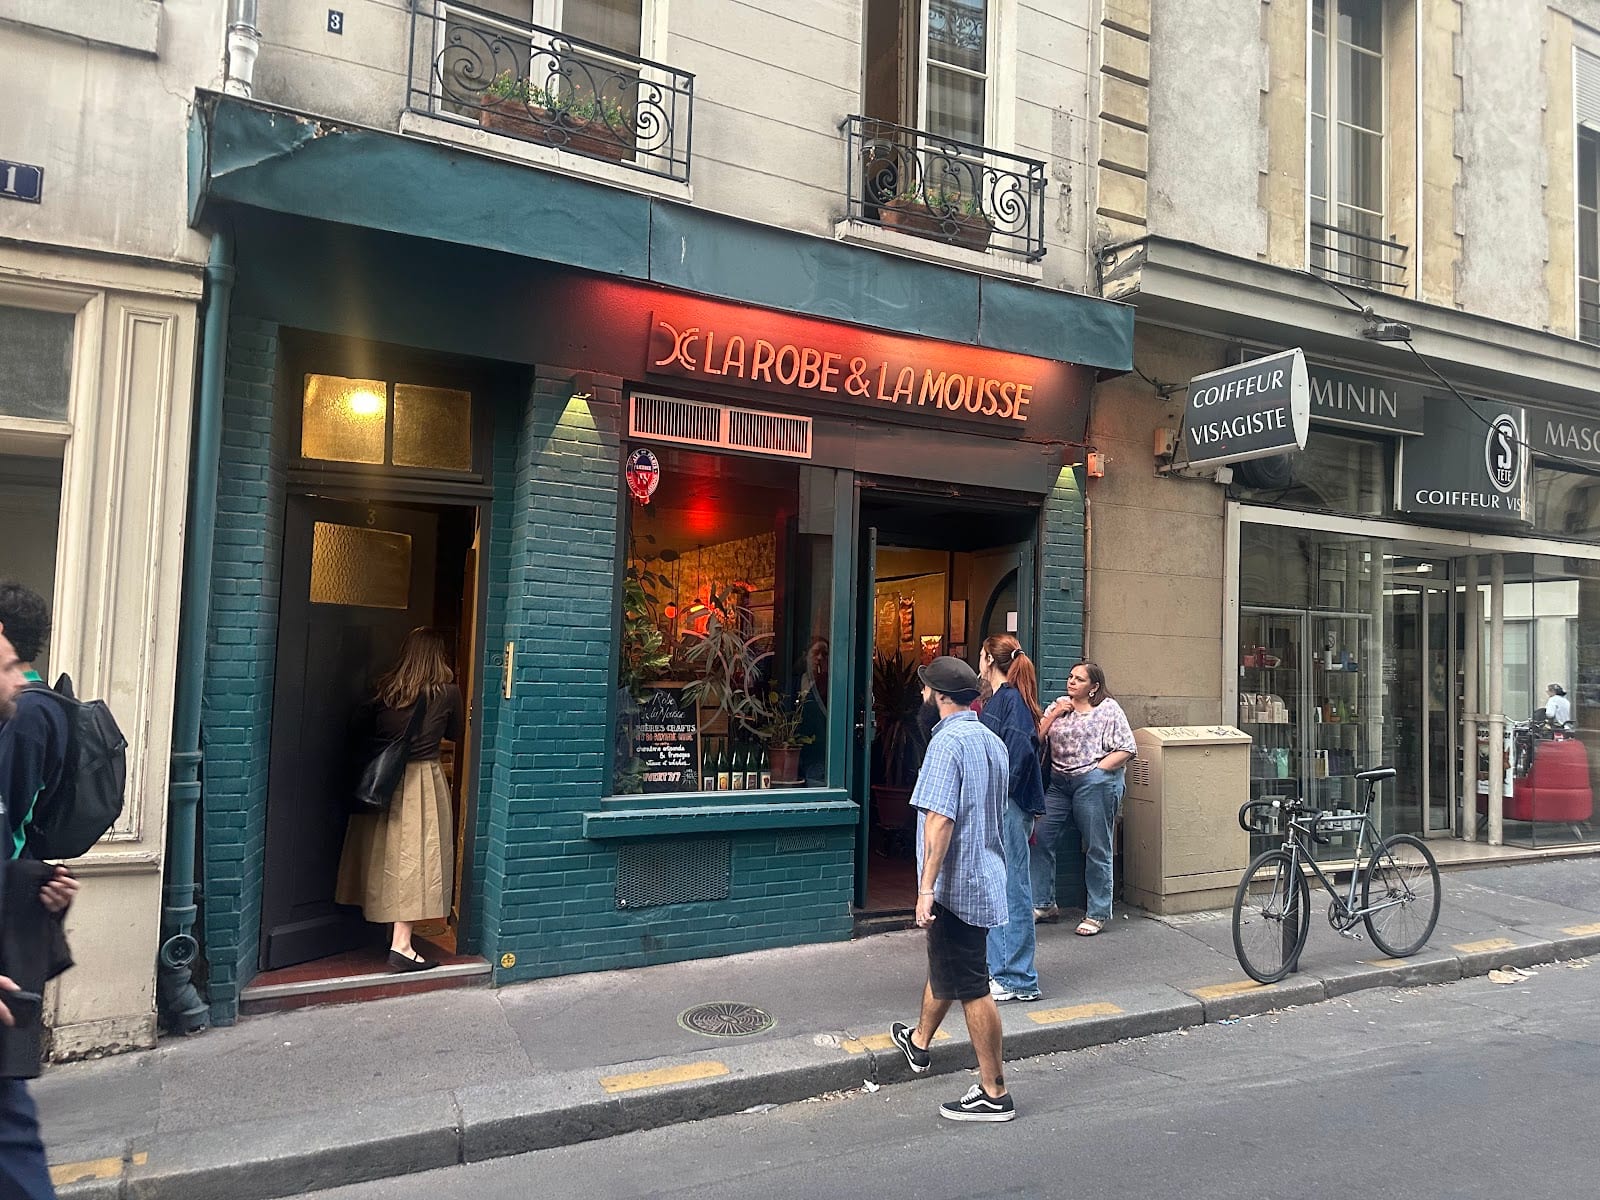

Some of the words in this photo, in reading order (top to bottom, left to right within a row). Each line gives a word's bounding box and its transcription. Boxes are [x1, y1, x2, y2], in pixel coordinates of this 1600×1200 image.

[329, 13, 341, 31] 3
[4, 165, 16, 194] 1
[703, 330, 746, 379] LA
[751, 339, 842, 394] ROBE
[844, 355, 872, 399] &
[876, 361, 915, 406] LA
[917, 367, 1034, 422] MOUSSE
[1192, 368, 1285, 409] COIFFEUR
[1190, 408, 1287, 446] VISAGISTE
[1415, 489, 1500, 510] COIFFEUR
[367, 509, 376, 525] 3
[666, 724, 695, 732] CRAFTS
